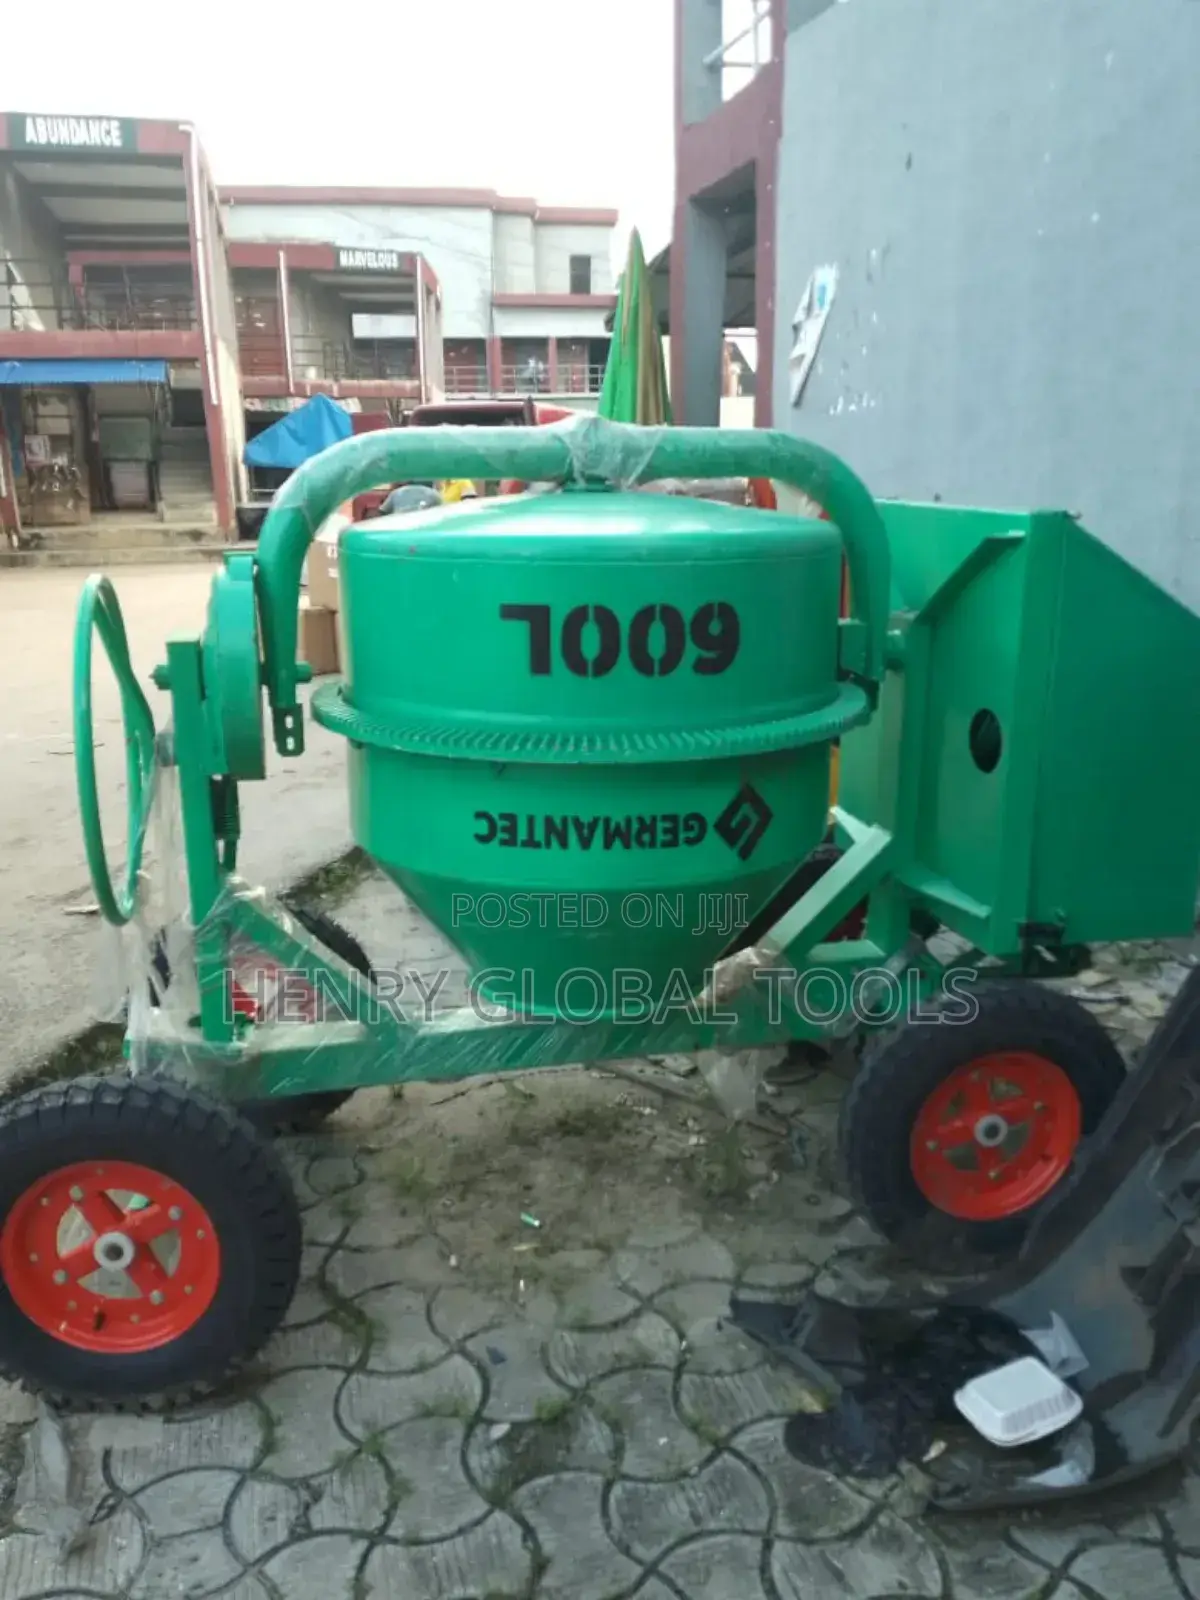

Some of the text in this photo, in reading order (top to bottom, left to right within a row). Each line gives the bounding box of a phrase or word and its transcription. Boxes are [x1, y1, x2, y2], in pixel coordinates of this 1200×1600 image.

[25, 116, 122, 147] ABUNDANCE
[499, 602, 741, 678] 600L
[473, 811, 708, 850] GERMANTEC
